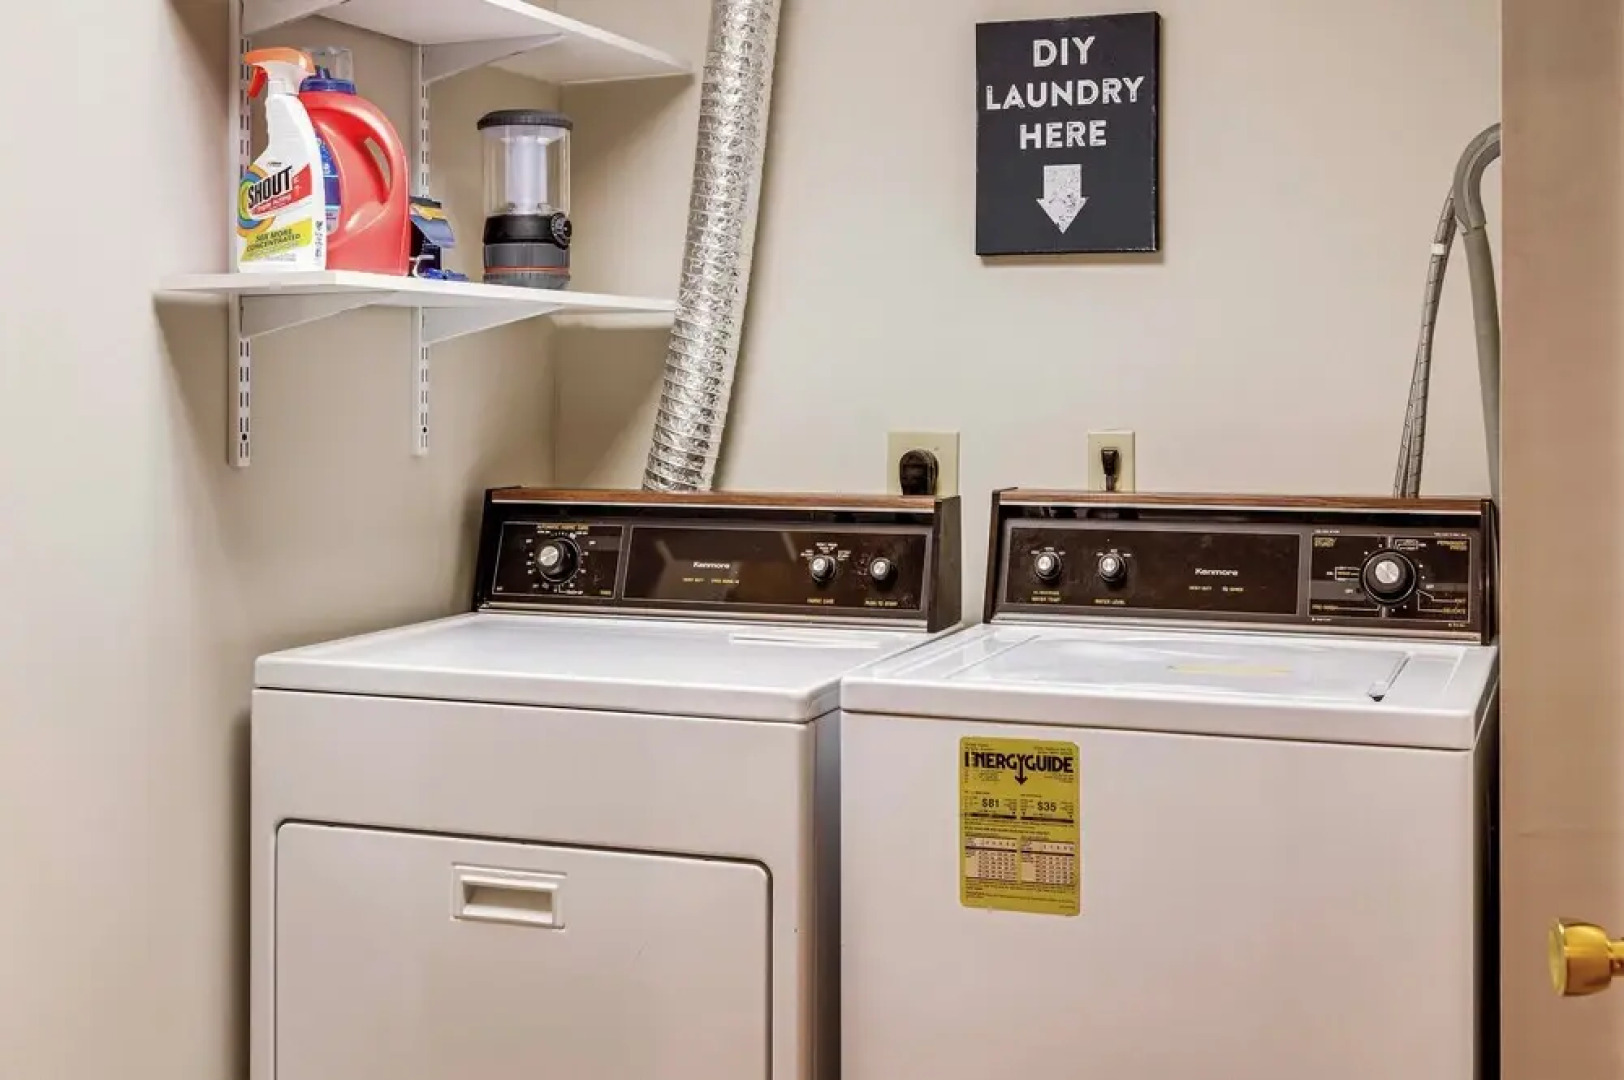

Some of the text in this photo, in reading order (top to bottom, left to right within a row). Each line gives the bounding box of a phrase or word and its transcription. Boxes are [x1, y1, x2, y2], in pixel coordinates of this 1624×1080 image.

[1032, 36, 1096, 67] DIY
[985, 76, 1145, 110] LAUNDRY
[1019, 120, 1107, 149] HERE
[248, 165, 292, 208] SHOUT
[692, 561, 730, 569] Kenmore
[1194, 567, 1239, 576] Kenmore
[1037, 801, 1057, 812] $35
